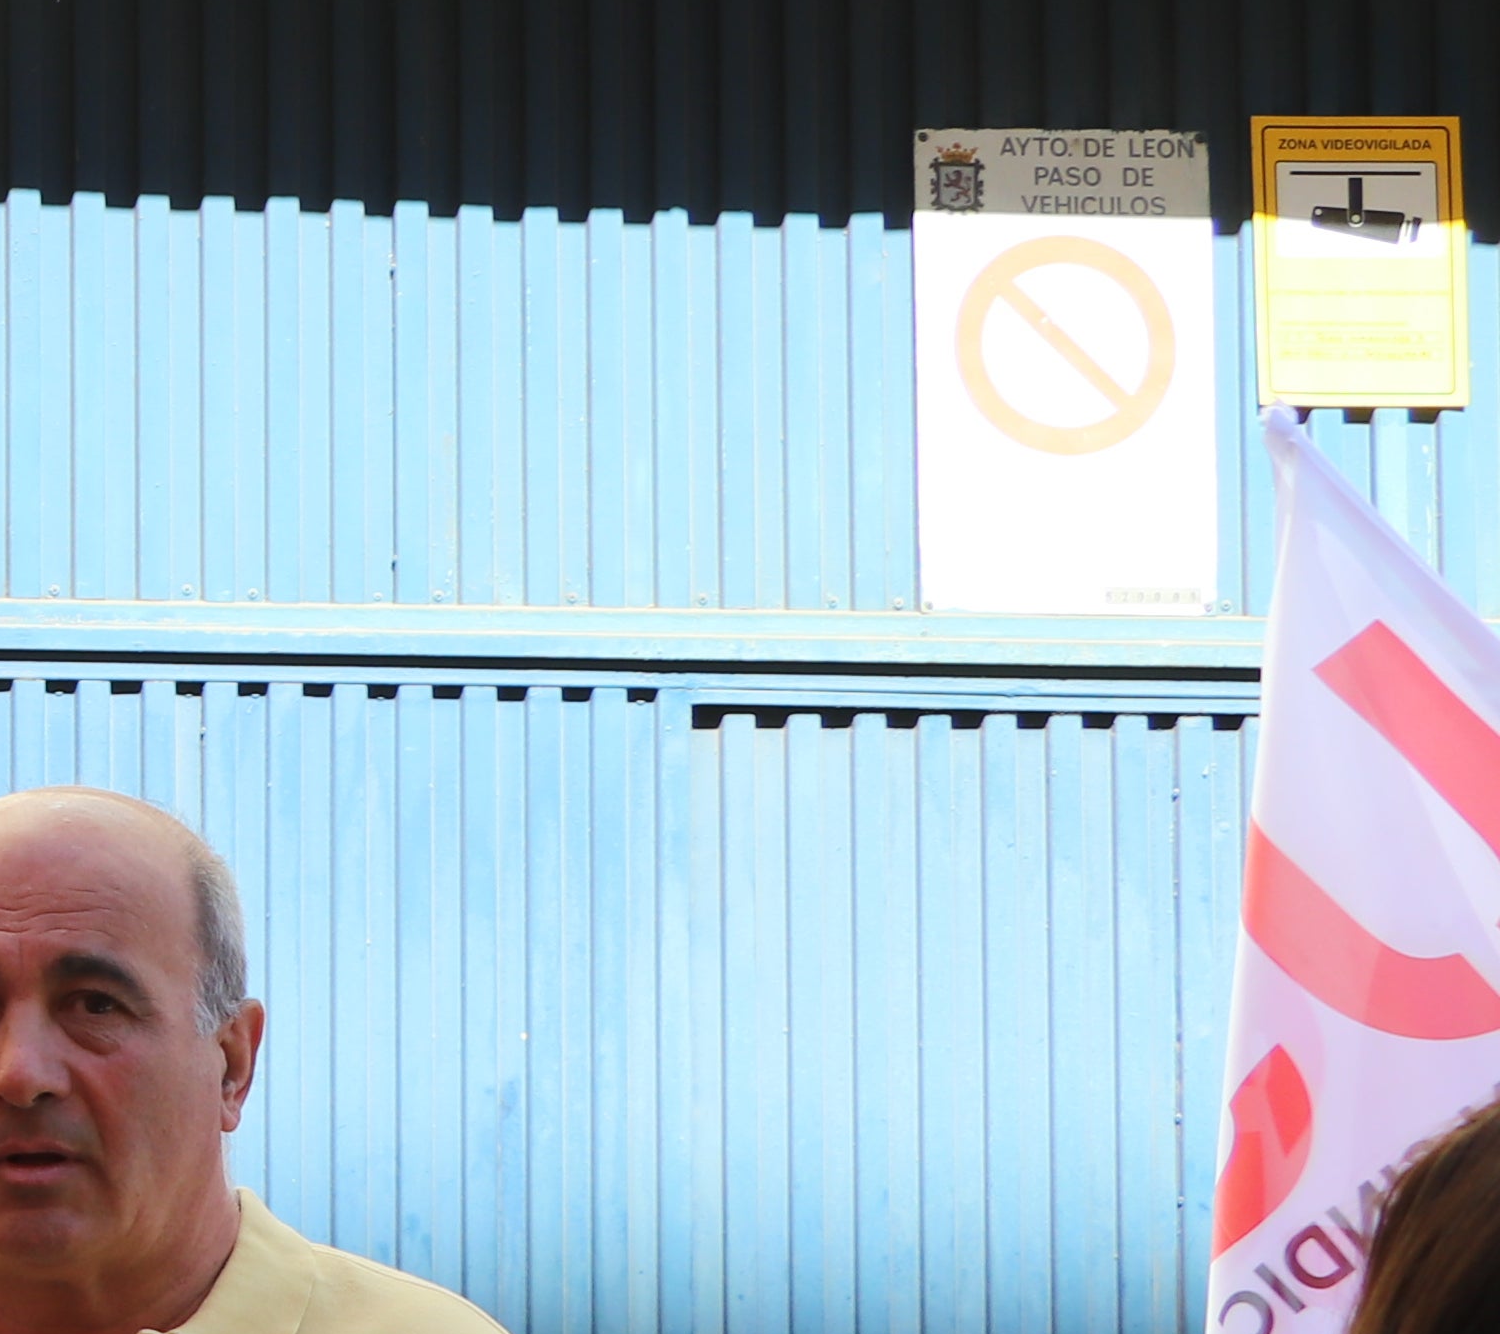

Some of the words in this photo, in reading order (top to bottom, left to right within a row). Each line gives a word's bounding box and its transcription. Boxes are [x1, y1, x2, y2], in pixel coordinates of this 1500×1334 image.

[1000, 137, 1073, 158] AYTO.
[1083, 138, 1115, 158] DE
[1128, 138, 1196, 159] LEON
[1278, 139, 1318, 150] ZONA
[1321, 139, 1432, 151] VIDEOVIGILADA
[1033, 167, 1102, 187] PASO
[1122, 167, 1155, 187] DE
[1020, 195, 1167, 216] VEHICULOS
